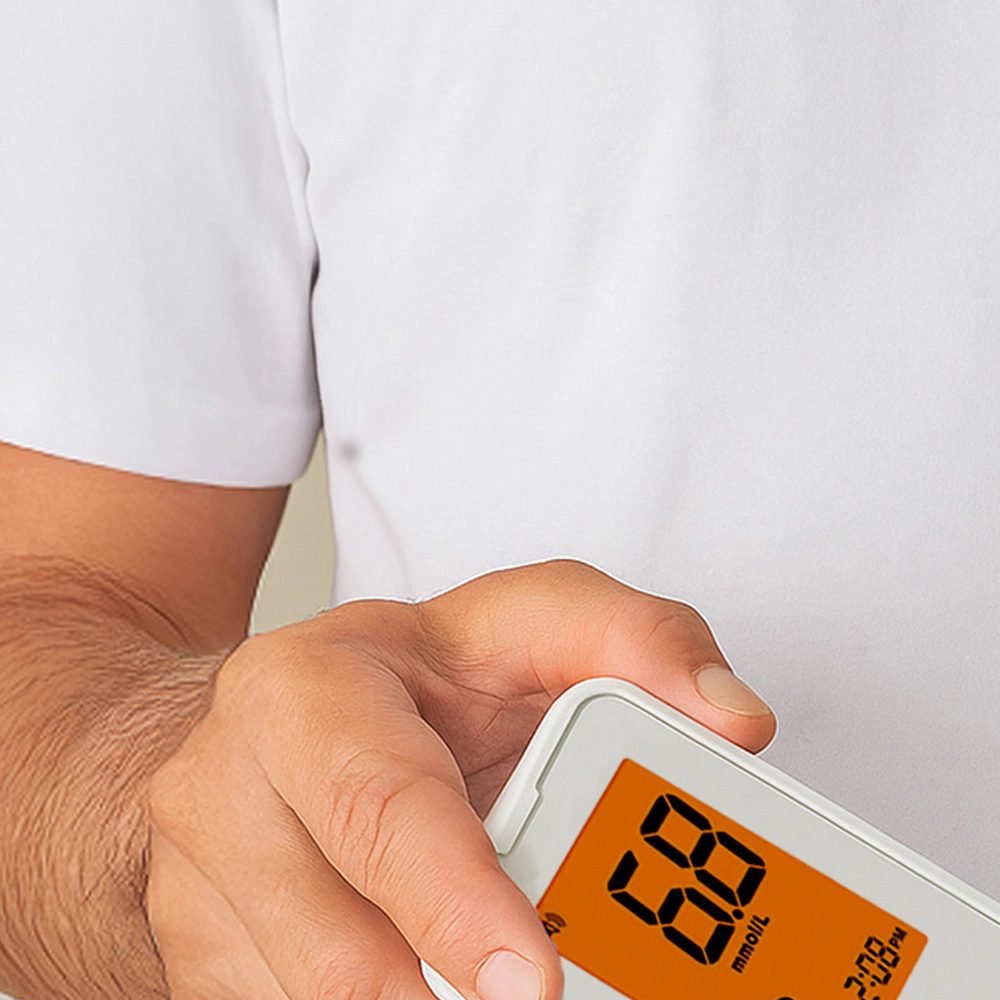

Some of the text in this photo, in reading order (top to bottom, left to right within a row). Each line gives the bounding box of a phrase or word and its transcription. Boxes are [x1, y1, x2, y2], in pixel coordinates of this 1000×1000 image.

[607, 794, 767, 966] 6.8
[731, 914, 771, 974] mmol/L
[888, 926, 908, 950] PM
